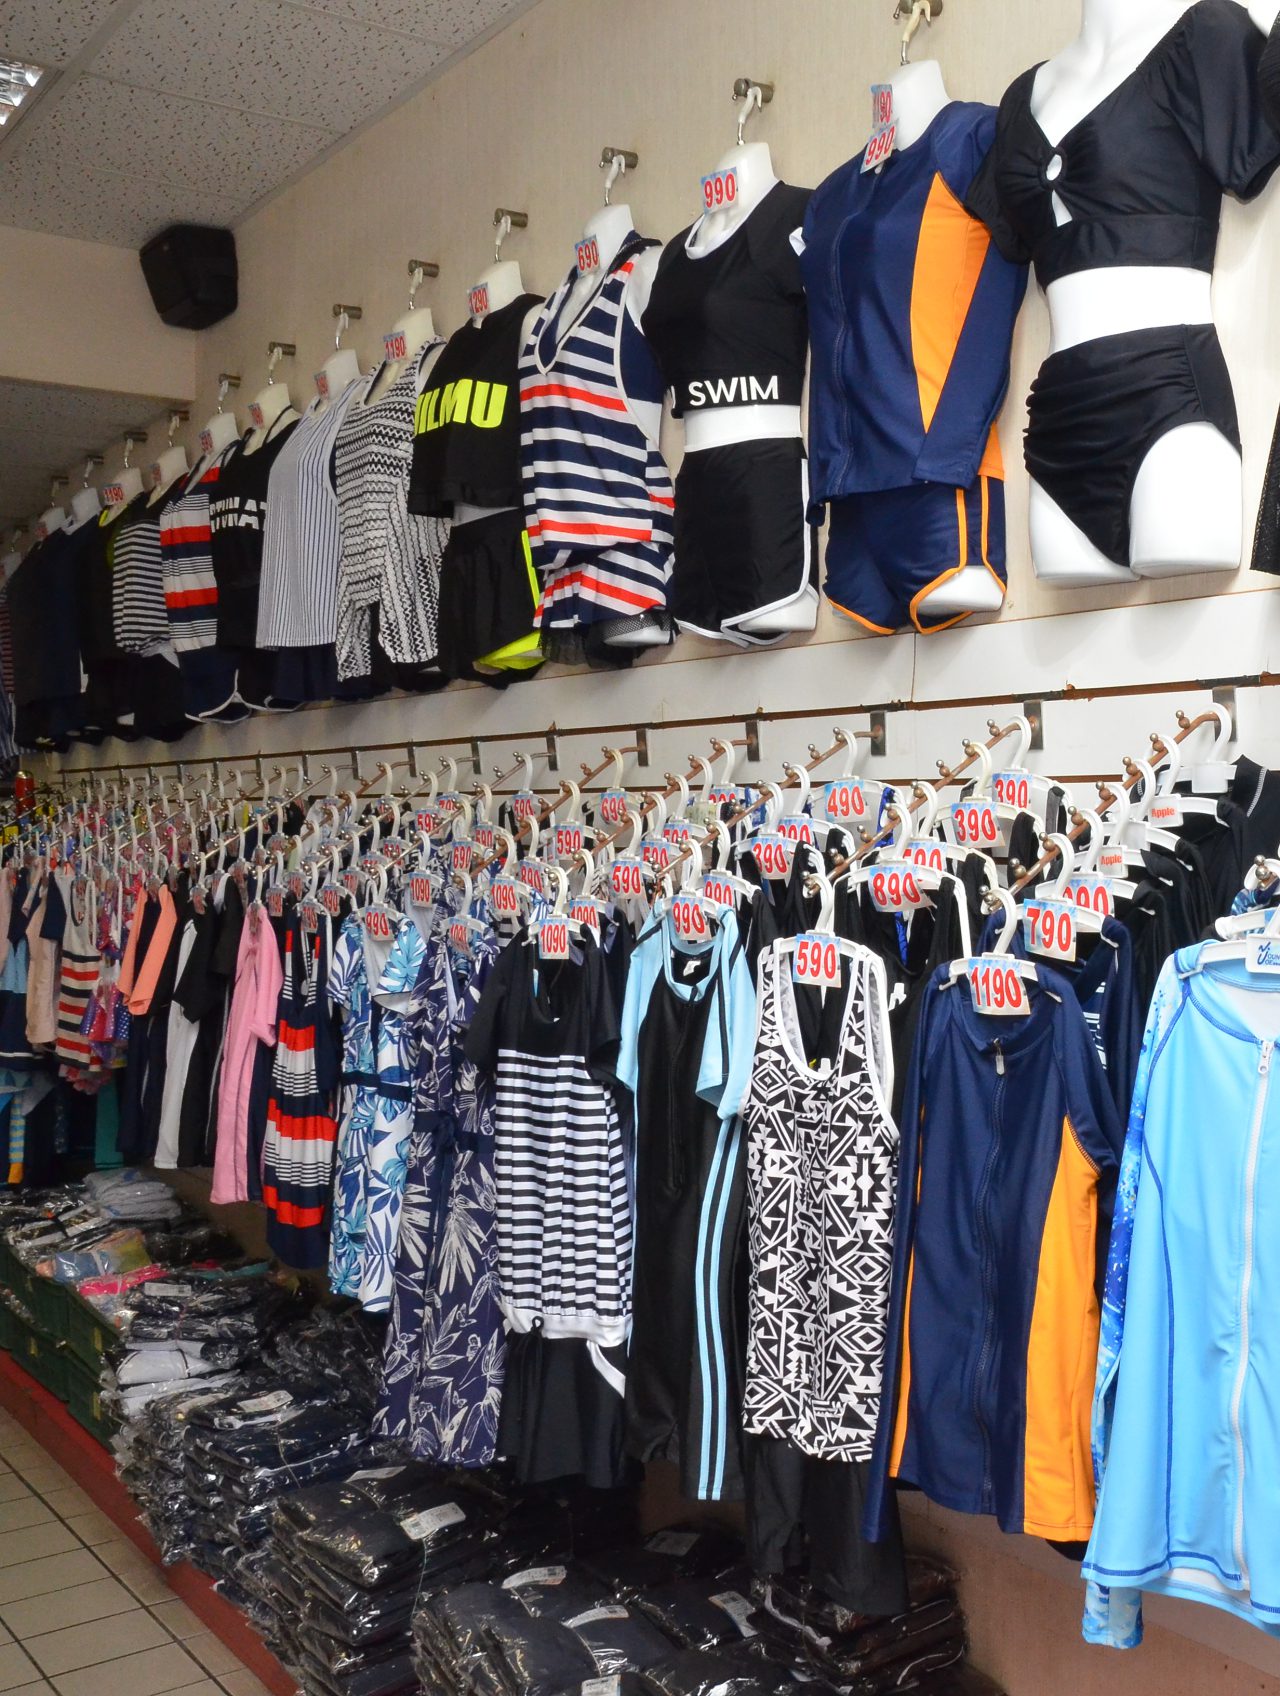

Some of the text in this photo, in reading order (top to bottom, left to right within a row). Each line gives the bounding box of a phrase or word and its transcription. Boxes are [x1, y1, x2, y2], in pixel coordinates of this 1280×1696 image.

[866, 125, 895, 166] 990
[704, 173, 736, 208] 990
[578, 240, 598, 271] 690
[385, 337, 406, 359] 1190
[688, 375, 779, 407] SWIM
[826, 786, 865, 818] 490
[994, 779, 1029, 808] 390
[954, 808, 997, 842] 390
[453, 846, 472, 869] 690
[557, 830, 581, 855] 590
[753, 842, 788, 874] 390
[410, 878, 431, 903] 1090
[612, 865, 641, 894] 590
[873, 871, 920, 907] 890
[491, 884, 517, 911] 1090
[366, 912, 390, 936] 990
[673, 902, 706, 935] 990
[1026, 907, 1072, 953] 790
[540, 924, 566, 954] 1090
[797, 940, 837, 980] 590
[971, 966, 1023, 1009] 1190
